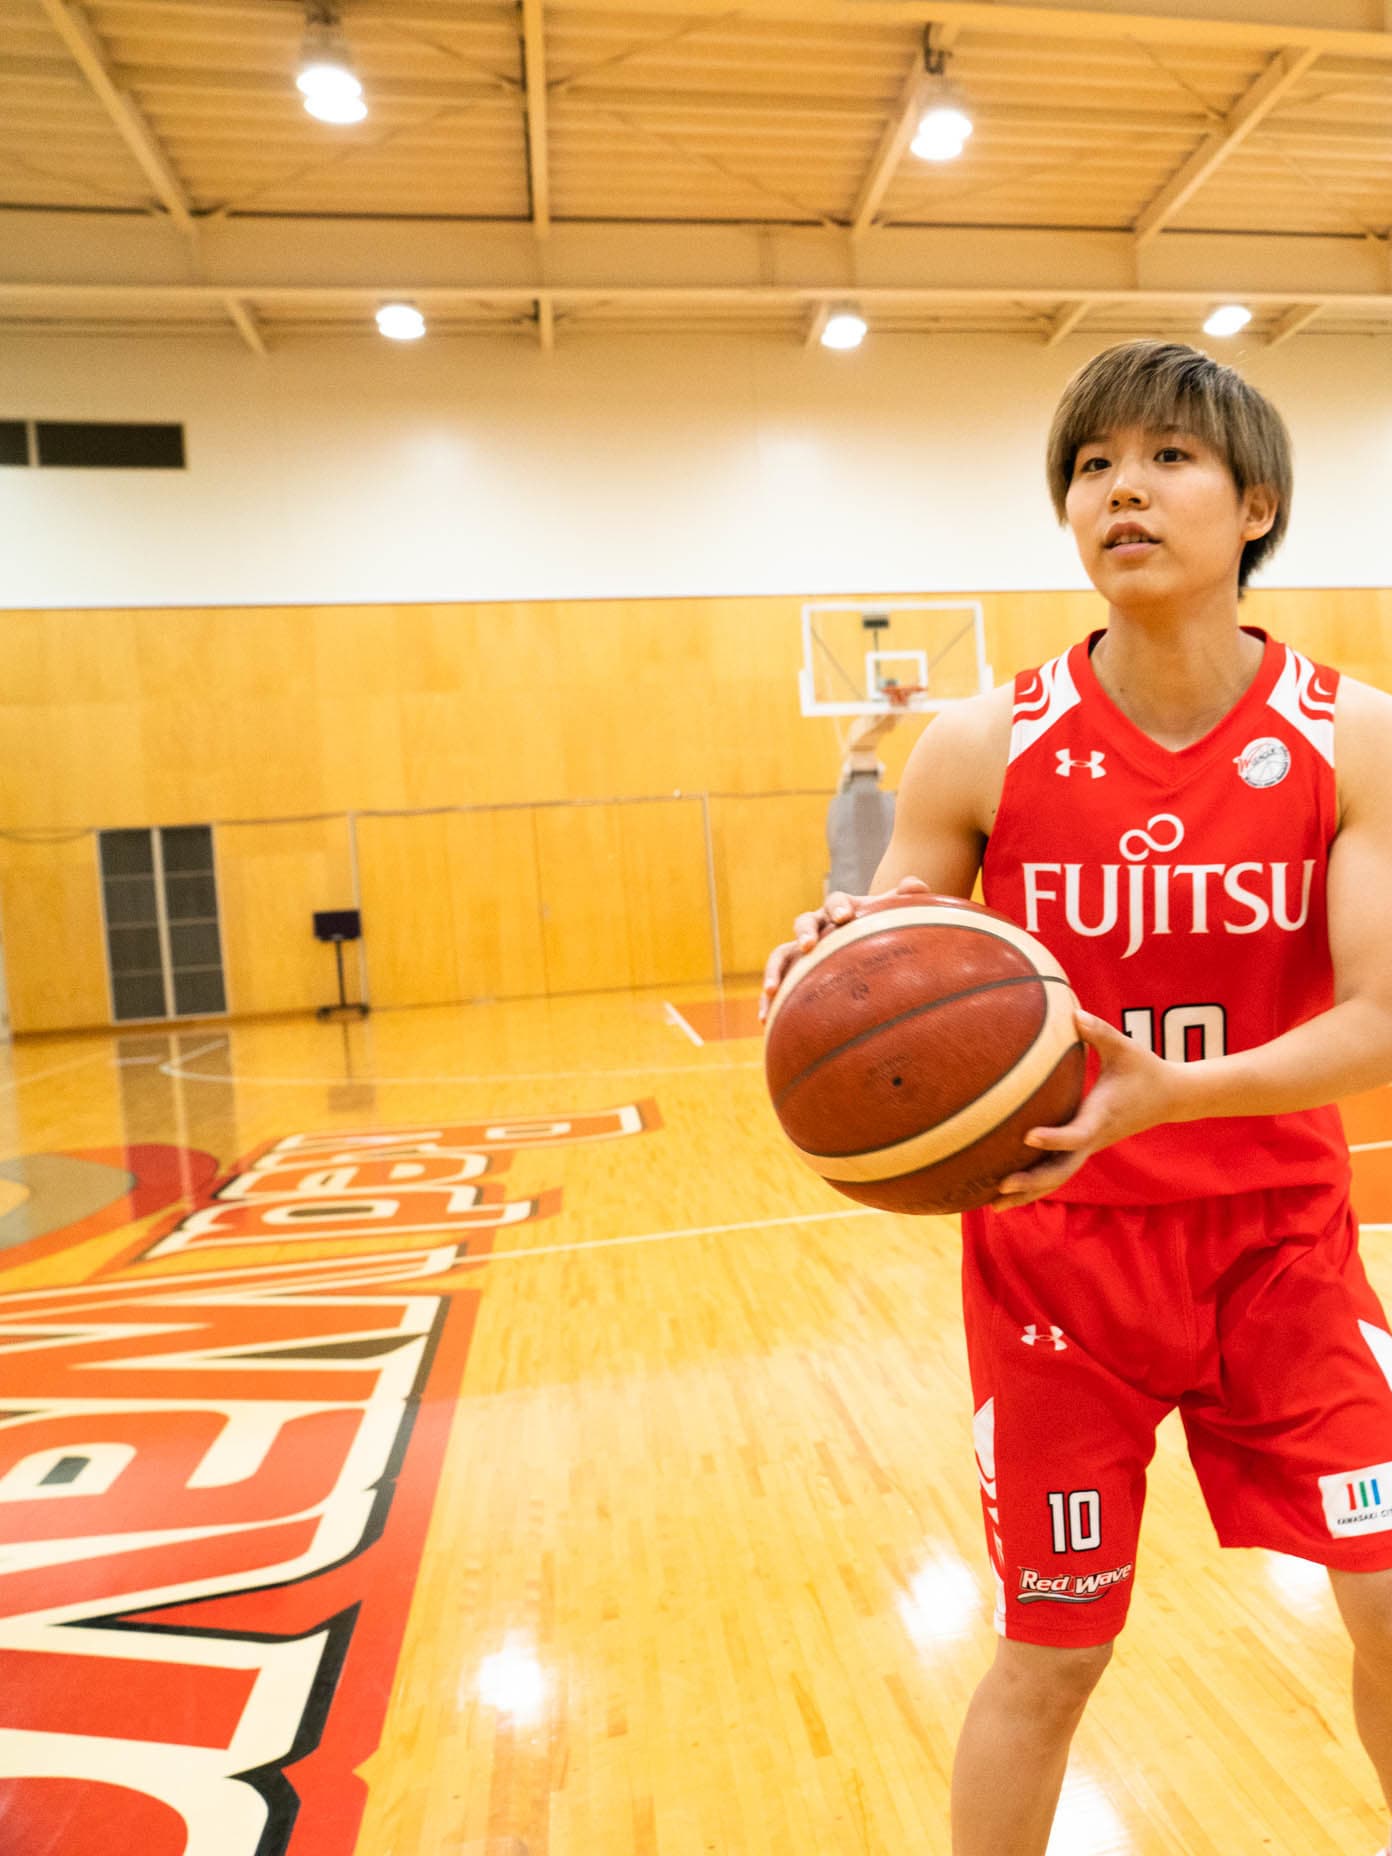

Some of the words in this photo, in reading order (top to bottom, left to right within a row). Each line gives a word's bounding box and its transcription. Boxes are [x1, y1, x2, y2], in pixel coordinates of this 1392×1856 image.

[1022, 859, 1317, 959] FUJITSU
[1047, 1489, 1102, 1554] 10
[1020, 1567, 1071, 1593] Red
[1074, 1562, 1133, 1595] Wave
